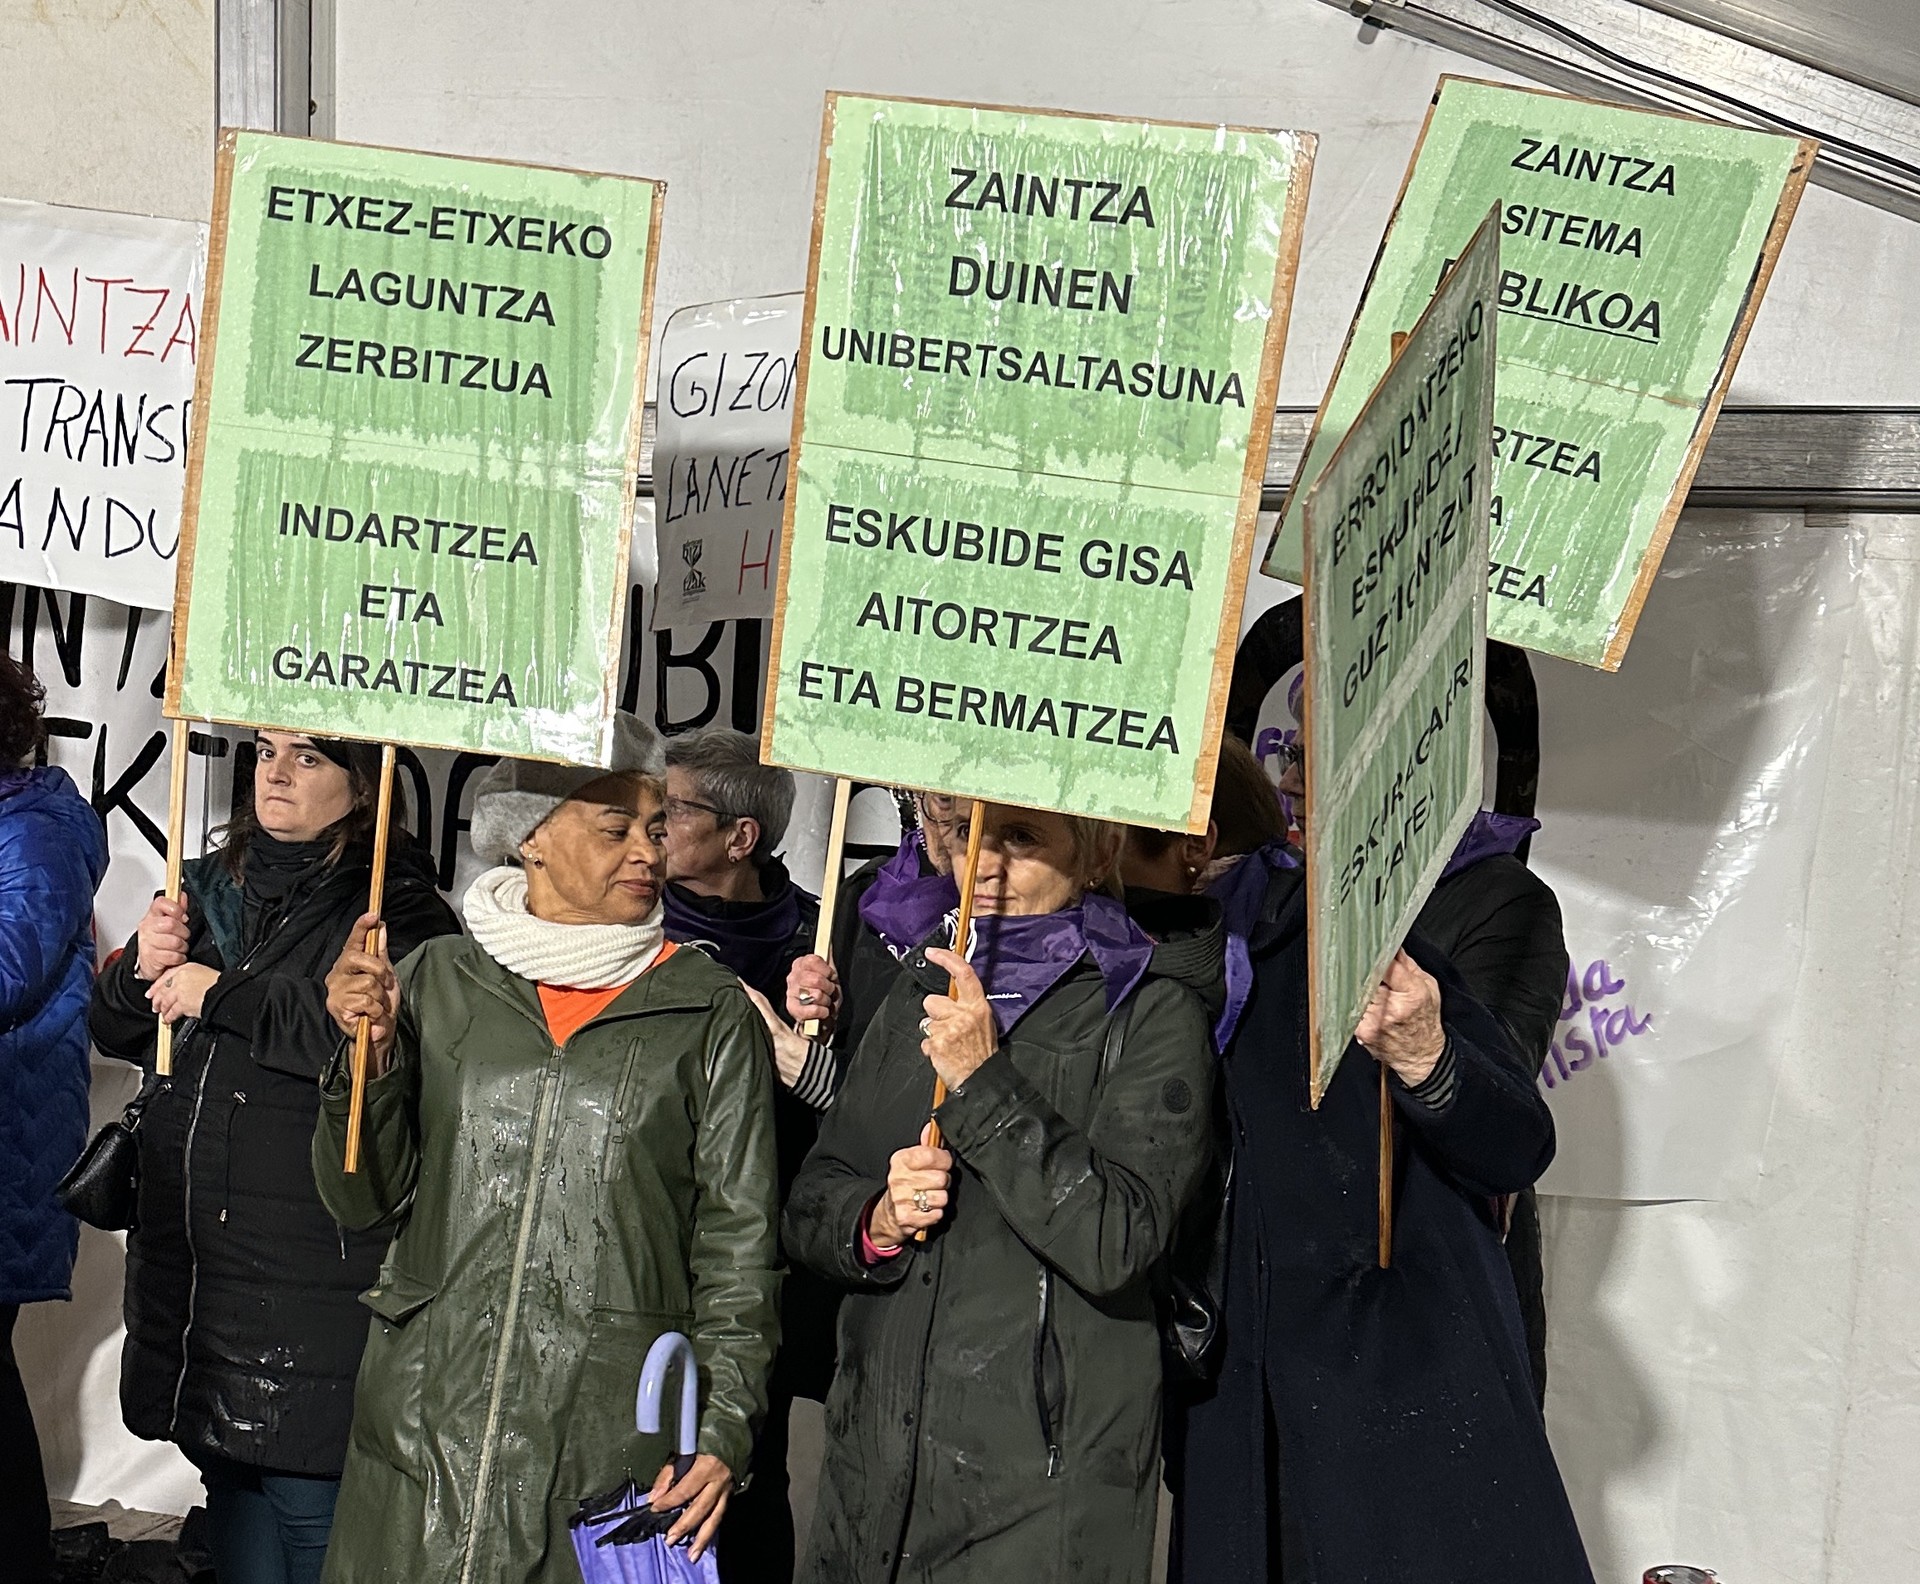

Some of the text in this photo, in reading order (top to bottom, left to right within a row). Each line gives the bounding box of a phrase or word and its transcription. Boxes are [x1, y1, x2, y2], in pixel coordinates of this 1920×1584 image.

[944, 167, 1155, 228] ZAINTZA
[1510, 138, 1675, 197] ZAINTZA
[267, 186, 612, 260] ETXEZ-ETXEKO
[309, 264, 556, 327] LAGUNTZA
[948, 255, 1133, 315] DUINEN
[1430, 258, 1661, 342] BLIKOA
[295, 334, 552, 399] ZERBITZUA
[822, 325, 1245, 408] UNIBERTSALTASUNA
[666, 447, 789, 523] LANET
[279, 502, 538, 566] INDARTZEA
[825, 503, 1194, 591] ESKUBIDE GISA
[360, 583, 444, 627] ETA
[856, 591, 1122, 665] AITORTZEA
[272, 646, 518, 708] GARATZEA
[798, 661, 1180, 755] ETA BERMATZEA
